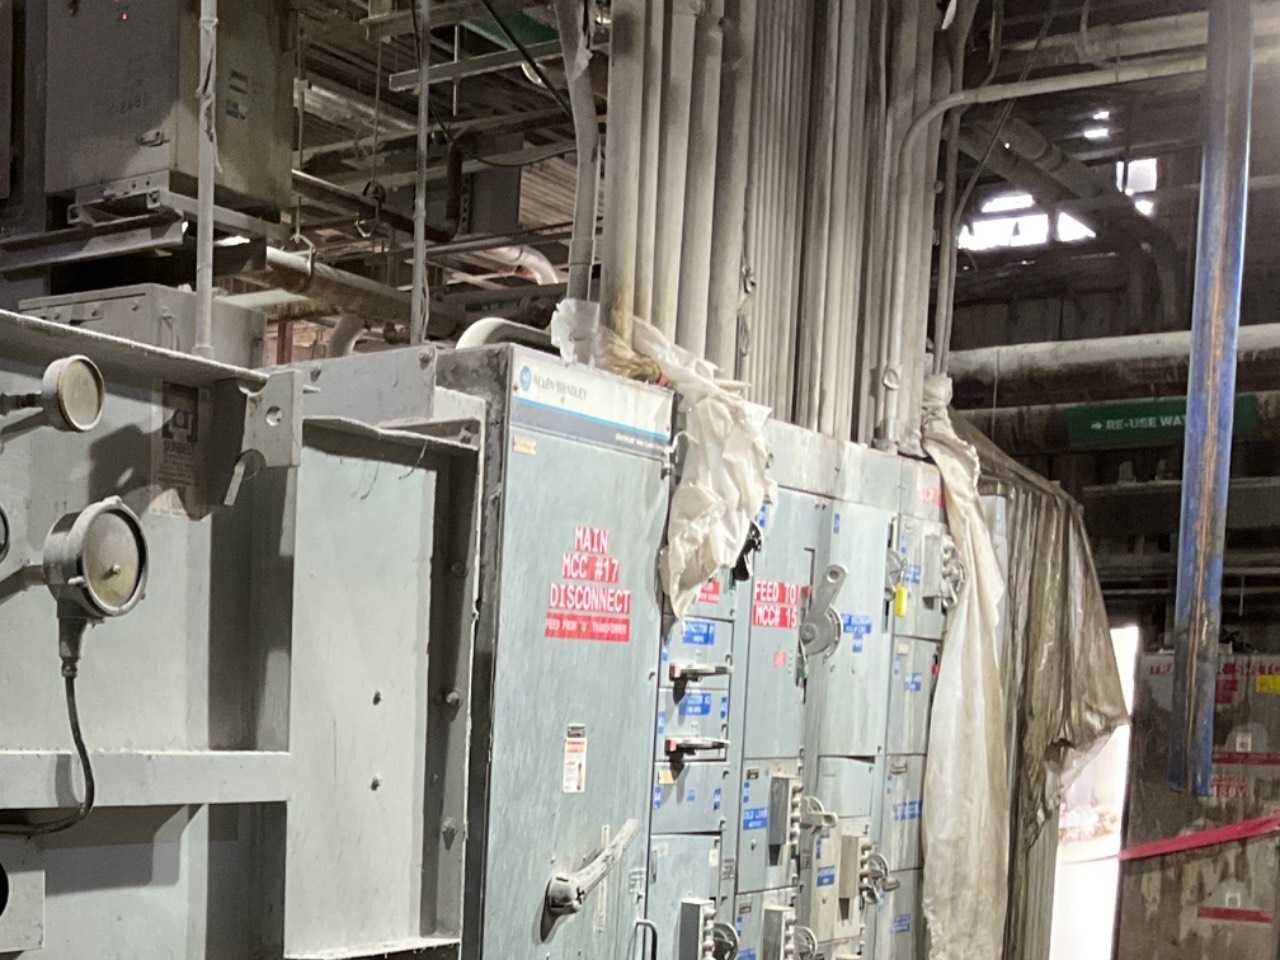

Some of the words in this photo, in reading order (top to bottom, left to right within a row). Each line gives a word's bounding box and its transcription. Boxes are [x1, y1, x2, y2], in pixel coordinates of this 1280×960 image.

[1106, 416, 1156, 430] RE-USE
[575, 526, 608, 553] MAIN
[562, 551, 588, 579] MCC
[594, 555, 619, 582] #17
[549, 582, 632, 613] DISCONNECT
[754, 580, 780, 602] FEED
